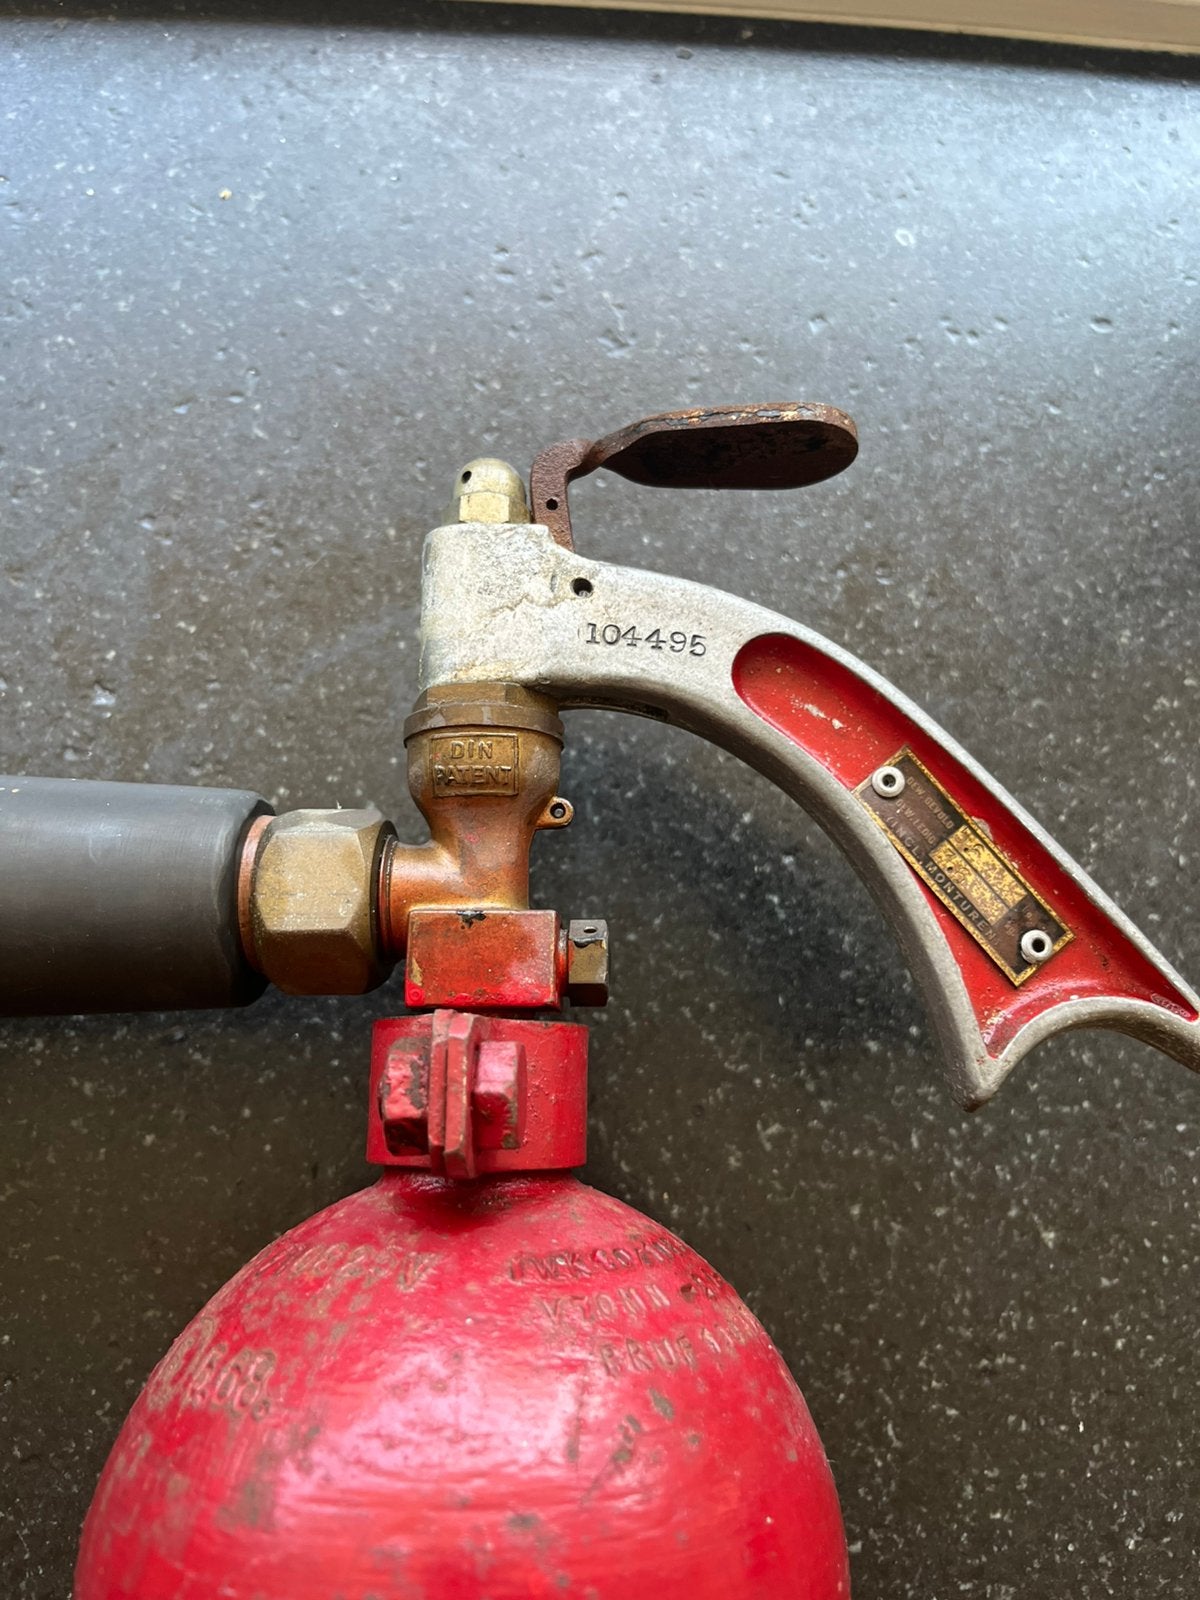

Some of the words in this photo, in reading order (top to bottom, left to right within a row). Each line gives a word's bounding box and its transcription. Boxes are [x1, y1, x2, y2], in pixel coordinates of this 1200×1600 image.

[586, 622, 707, 657] 104495
[451, 739, 493, 760] DIN
[434, 764, 512, 786] PATENT
